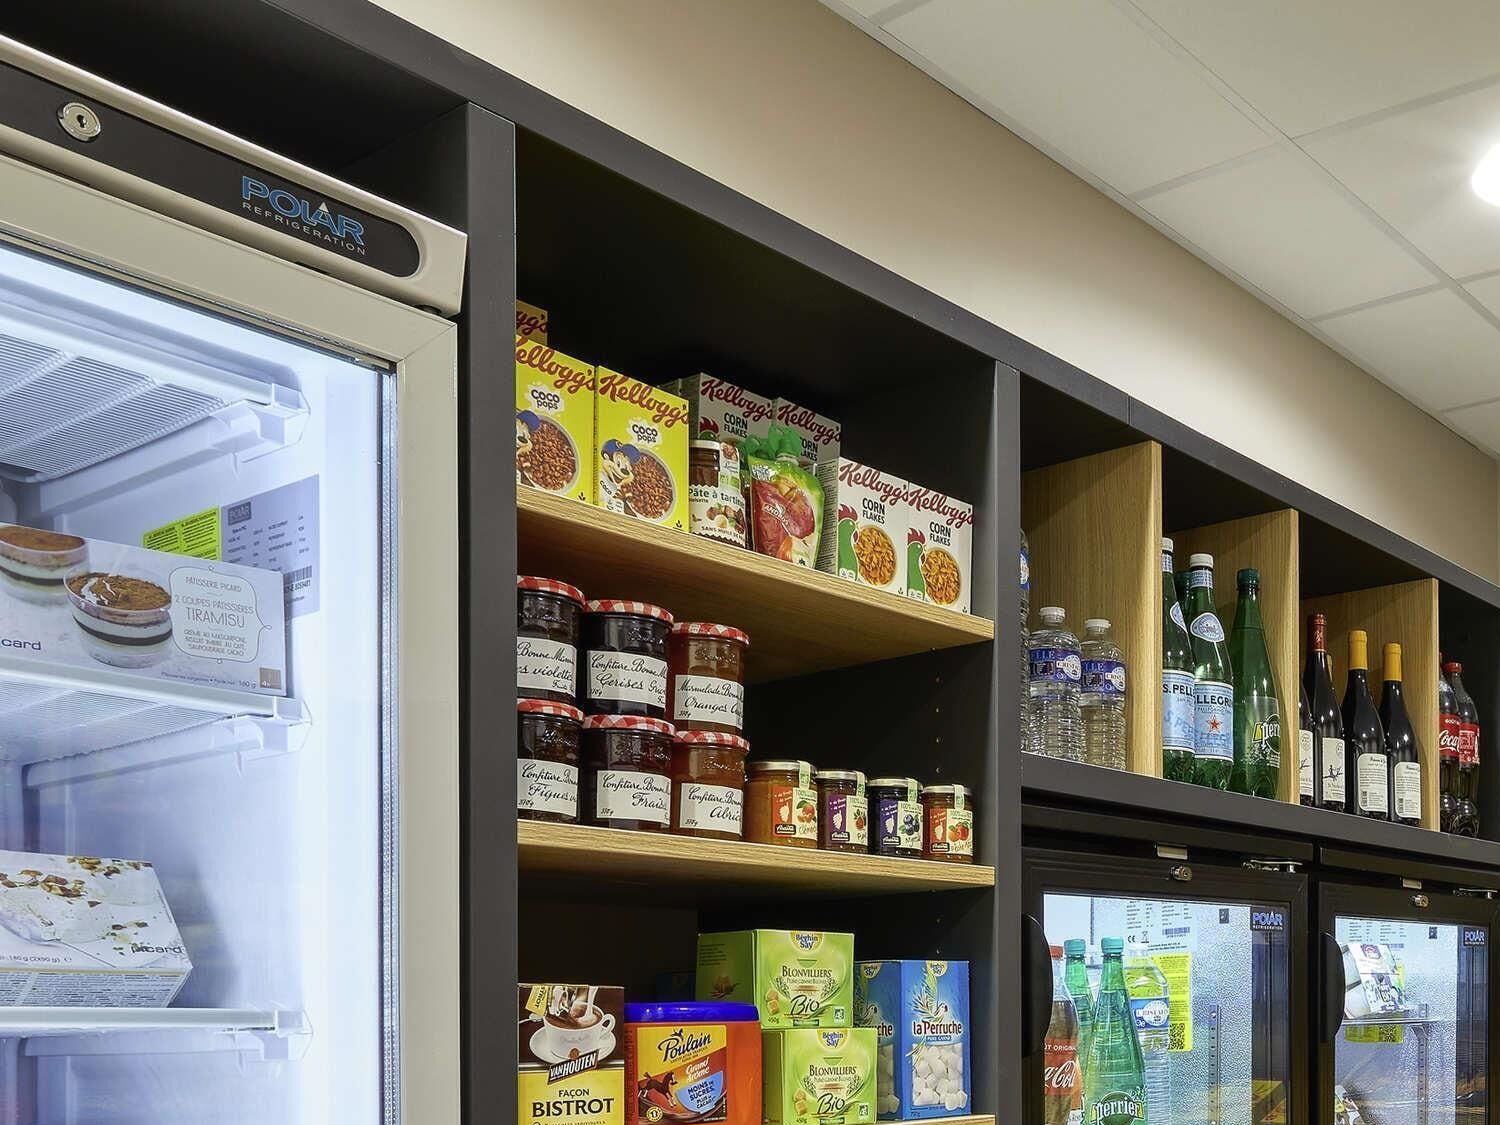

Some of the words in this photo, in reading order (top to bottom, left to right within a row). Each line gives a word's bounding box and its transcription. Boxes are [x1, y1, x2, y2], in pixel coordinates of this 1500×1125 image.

[243, 175, 364, 246] POLAR
[243, 202, 365, 255] REFRIGERATION
[536, 399, 558, 410] pops
[600, 374, 689, 429] Kellogg's
[702, 378, 774, 422] Kellogg's
[724, 412, 748, 430] CORN
[778, 403, 841, 445] Kellogg's
[637, 433, 656, 443] pops
[724, 424, 748, 439] FLAKES
[838, 462, 909, 507] Kellogg's
[862, 497, 886, 516] CORN
[908, 487, 975, 529] Kellogg's
[862, 510, 885, 525] FLAKES
[929, 521, 952, 539] CORN
[929, 533, 951, 547] FLAKES
[186, 606, 245, 628] TIRAMISU
[591, 654, 629, 671] Confiture
[596, 673, 644, 691] Cerises
[684, 695, 728, 713] Oranges
[521, 763, 562, 784] Confiture
[528, 783, 570, 801] Figues
[602, 774, 641, 795] Confiture
[688, 786, 725, 807] Confiture
[1252, 911, 1283, 926] POLAR
[796, 932, 818, 942] Béghin
[800, 940, 814, 950] Say
[1464, 931, 1485, 942] POLAR
[130, 943, 183, 954] picard
[790, 994, 820, 1016] Bio
[822, 1031, 844, 1040] Béghin
[914, 1022, 922, 1035] la
[922, 1020, 962, 1035] Perruche
[657, 1032, 712, 1062] Poulain
[826, 1039, 840, 1048] Say
[558, 1087, 590, 1099] FAÇON
[688, 1080, 709, 1094] MOINS
[689, 1086, 716, 1101] SUCRES
[532, 1098, 615, 1118] BISTROT
[817, 1092, 846, 1115] Bio
